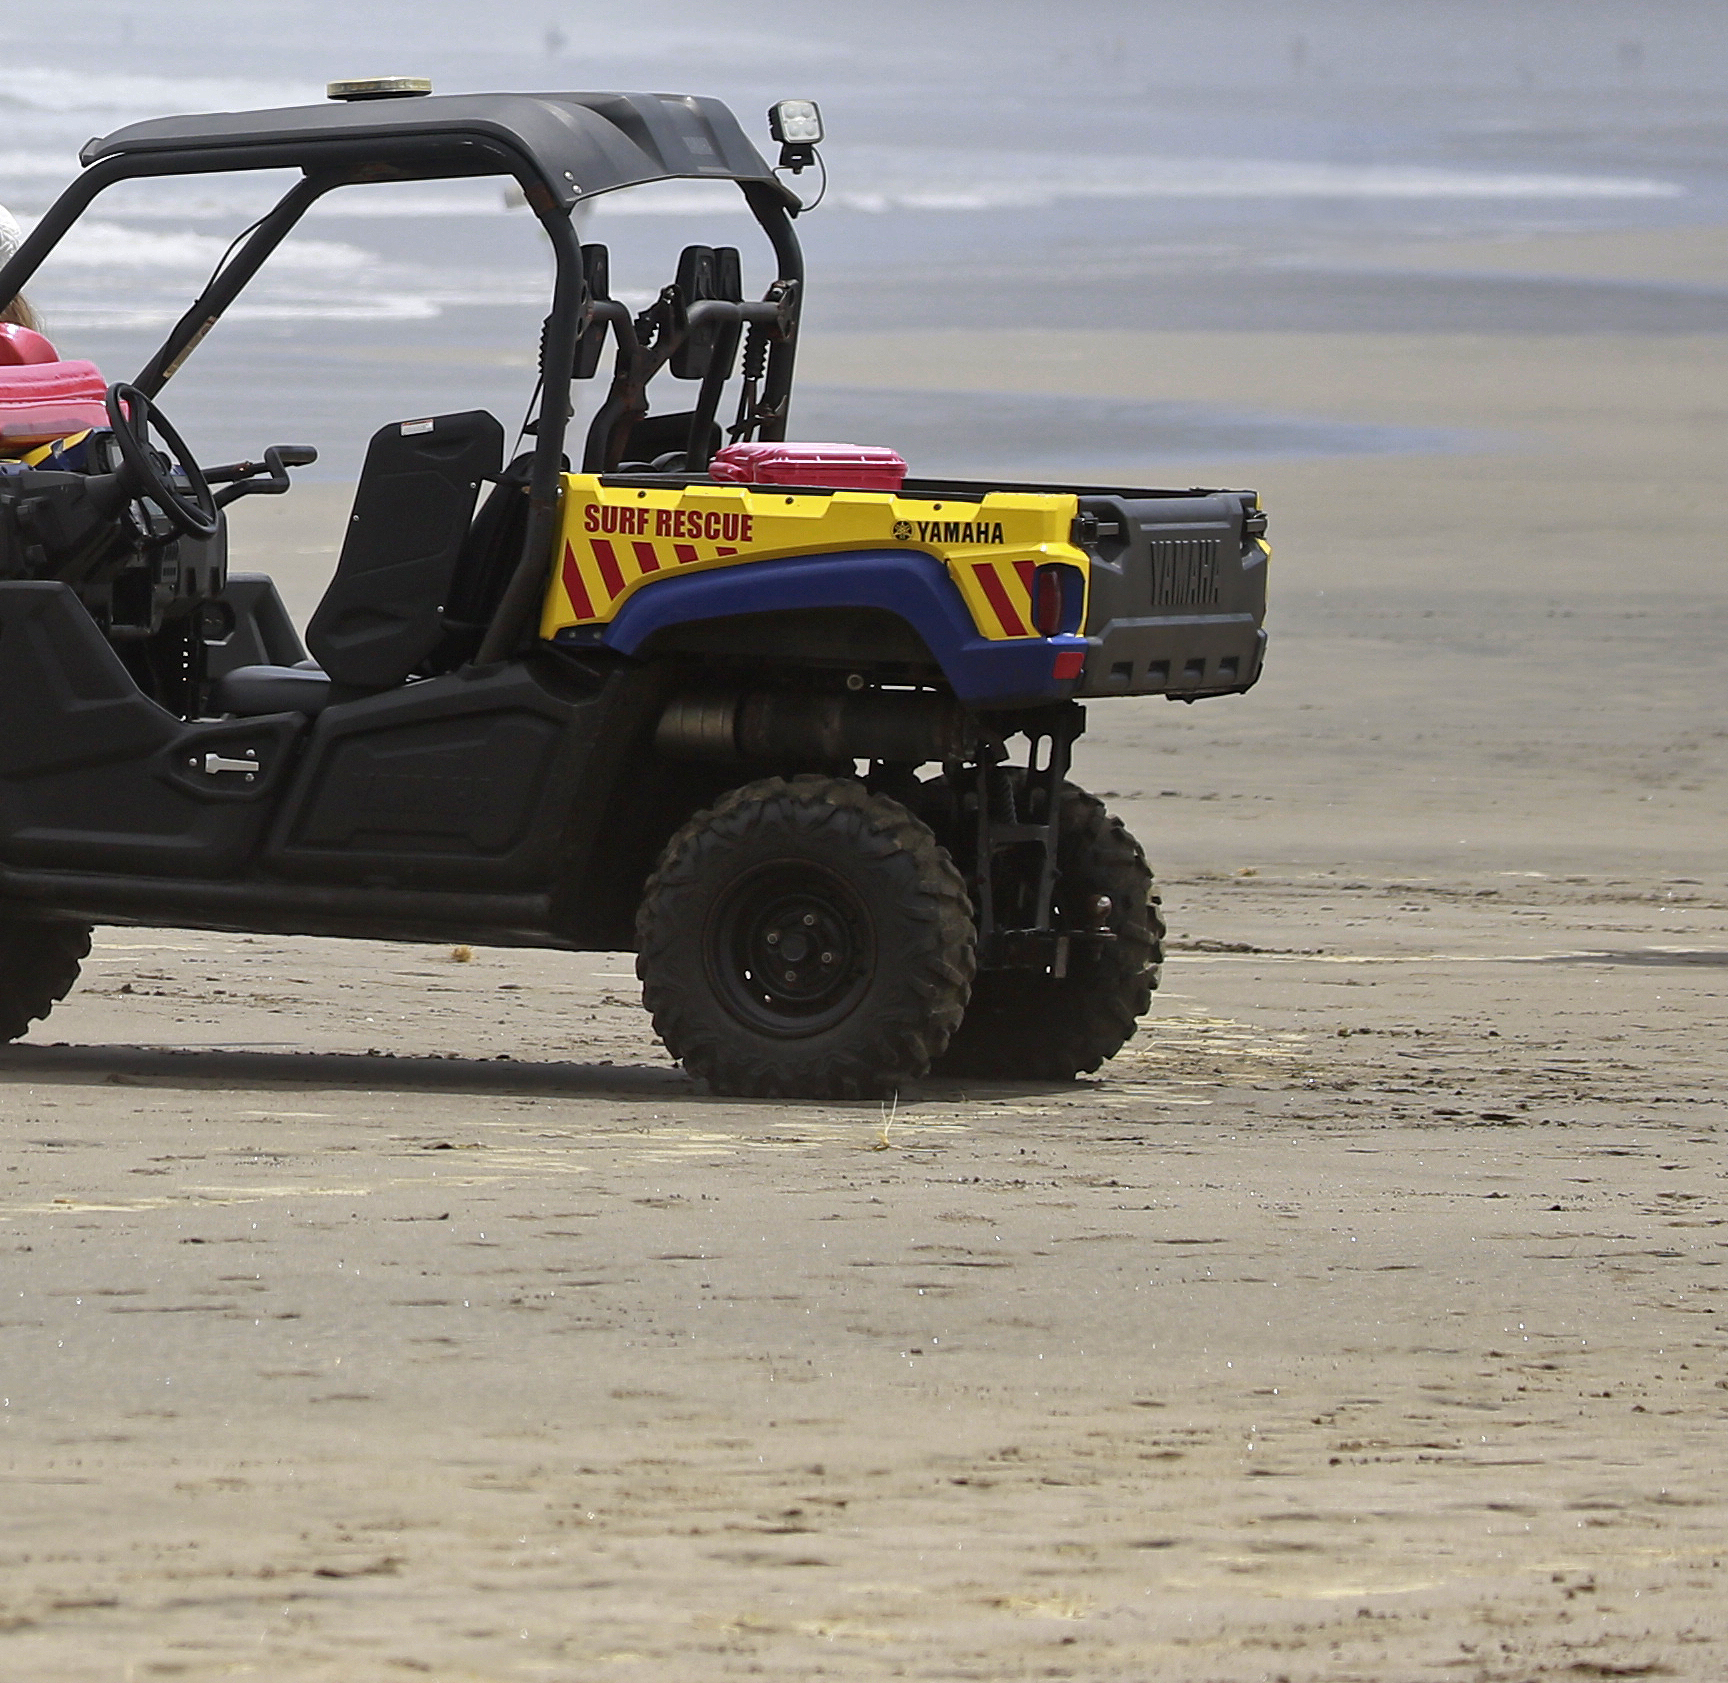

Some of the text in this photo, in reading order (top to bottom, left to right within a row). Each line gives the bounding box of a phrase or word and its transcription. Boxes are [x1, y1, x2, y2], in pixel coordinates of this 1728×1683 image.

[584, 503, 753, 542] SURF RESCUE
[917, 521, 1004, 544] YAMAHA
[1150, 539, 1221, 605] YAMAHA
